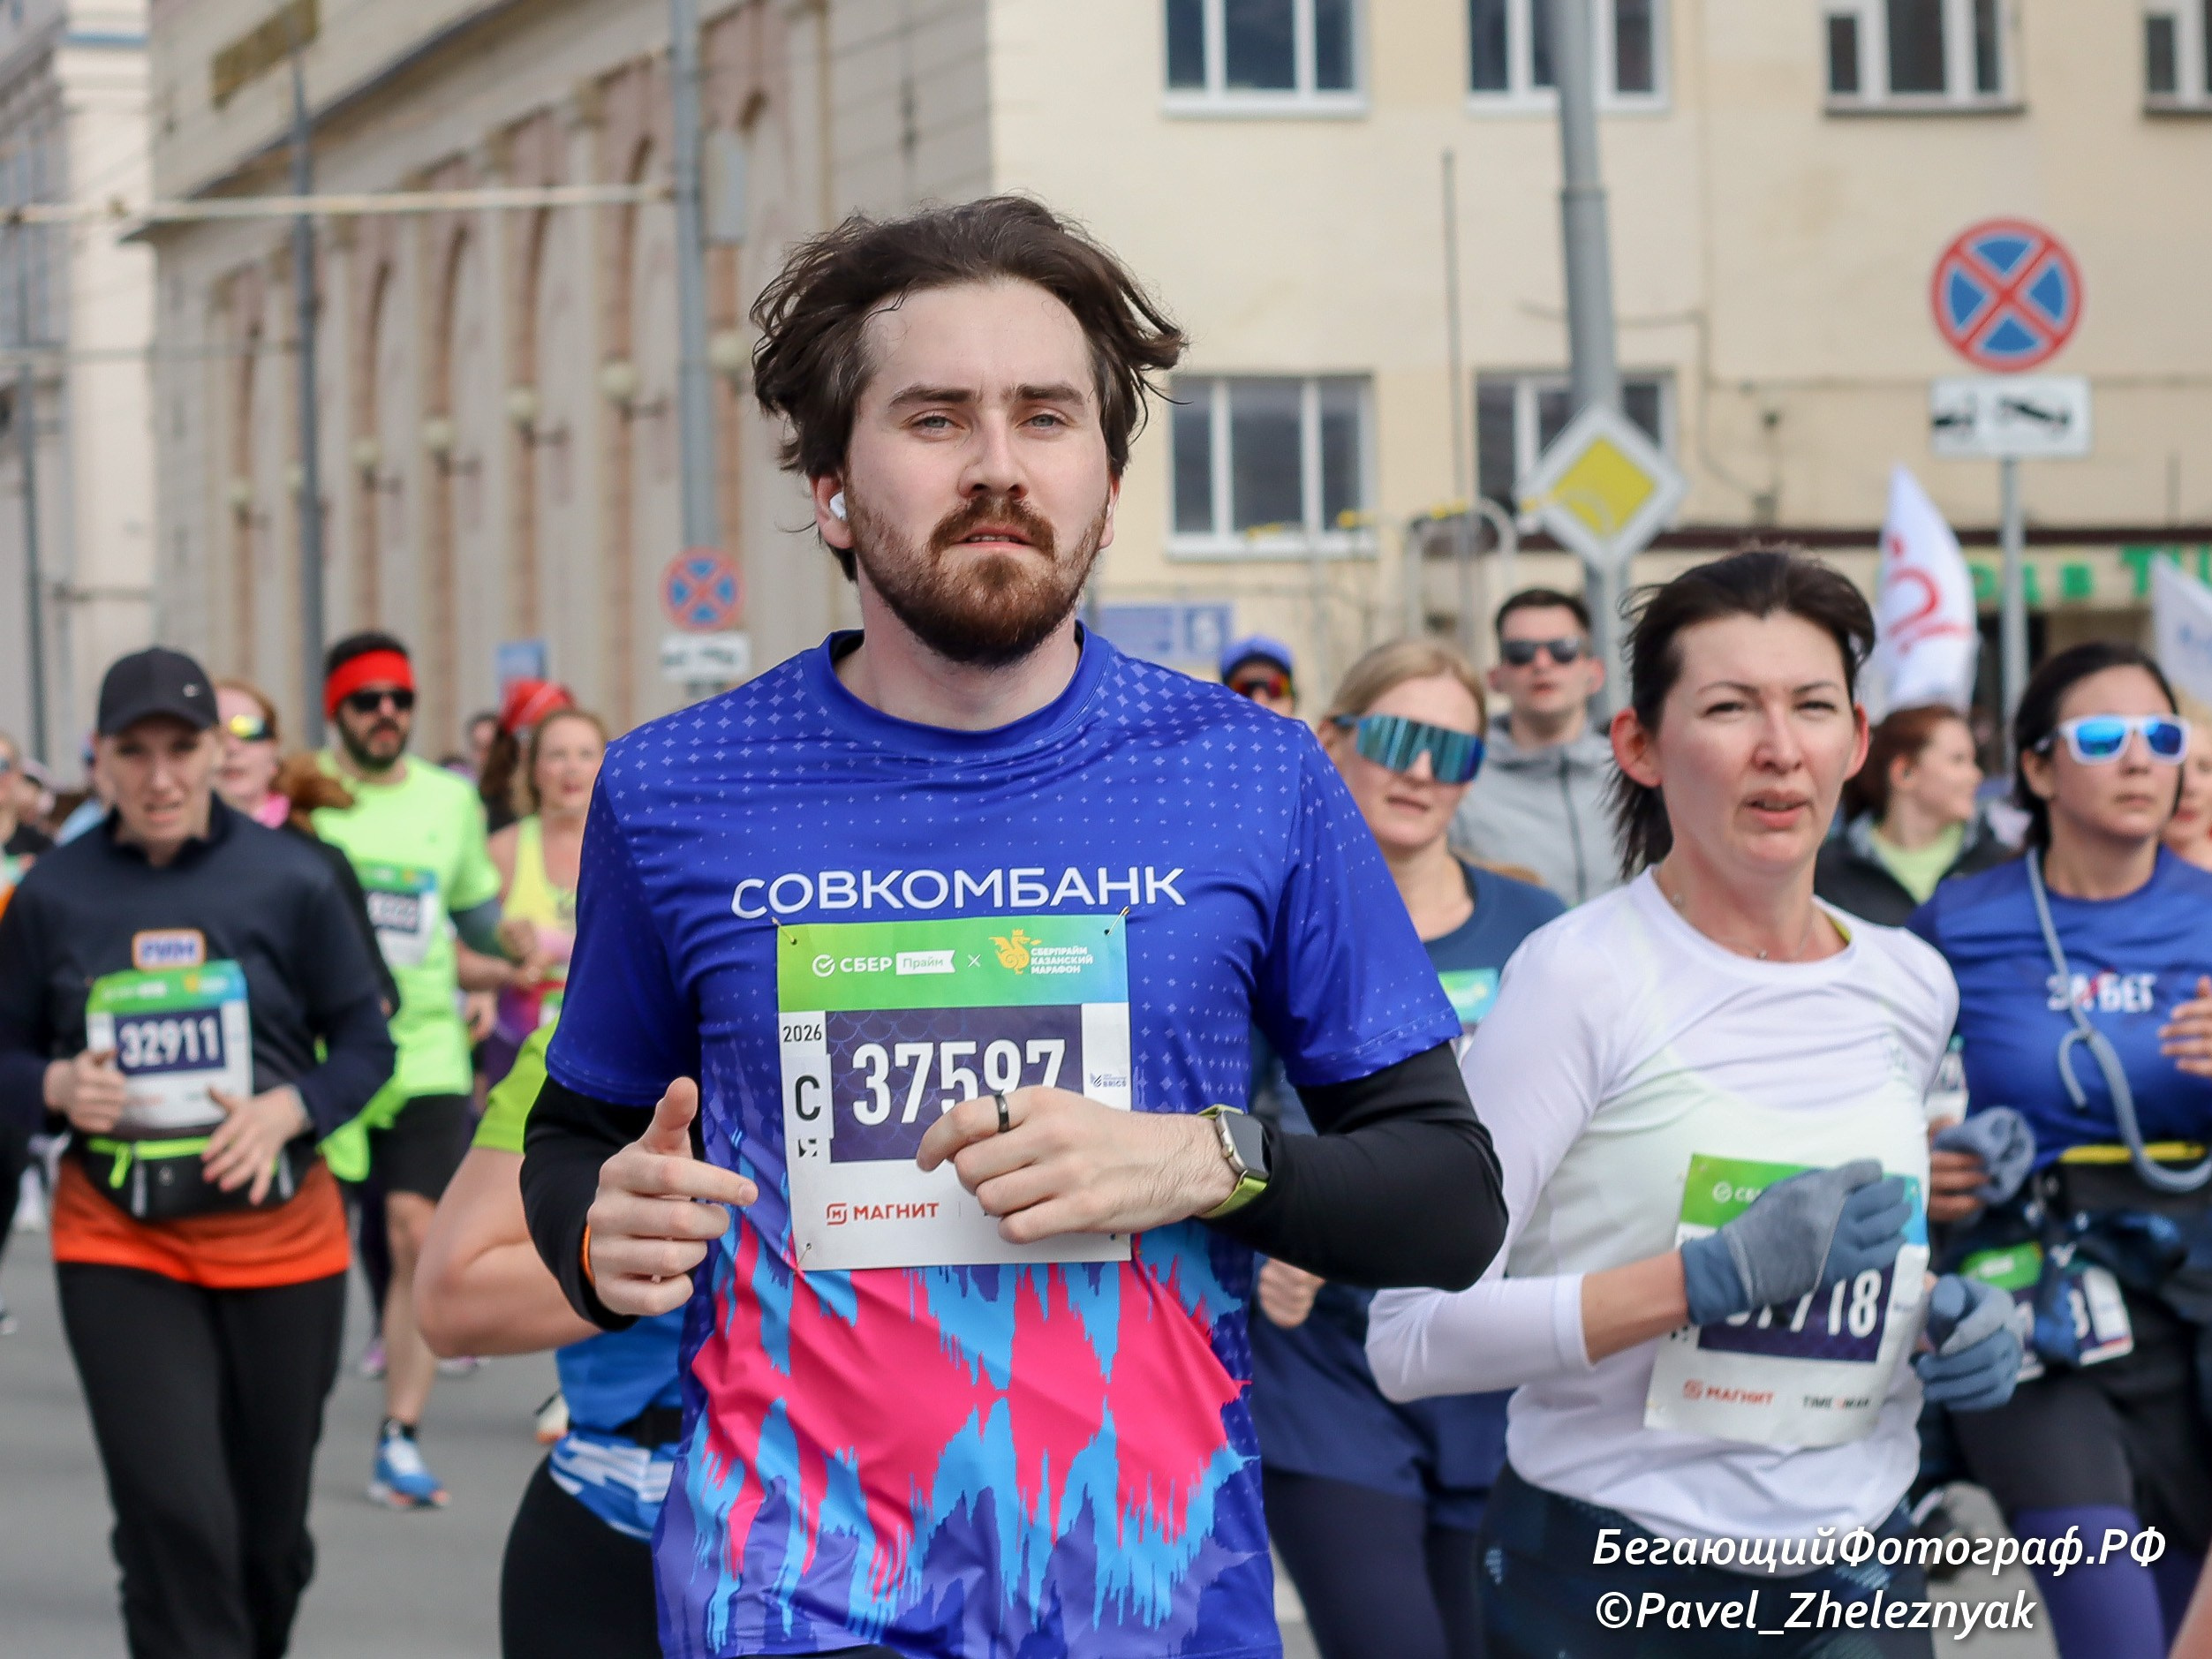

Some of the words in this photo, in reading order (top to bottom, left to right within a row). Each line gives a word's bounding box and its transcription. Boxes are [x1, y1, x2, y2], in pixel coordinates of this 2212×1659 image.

[730, 866, 1187, 919] СОВКОМБАНК
[1031, 946, 1089, 957] СБЕРПРАЙМ
[1031, 954, 1093, 966] КАЗАНСКИЙ
[840, 956, 893, 973] СБЕР
[902, 956, 944, 971] Прайм
[1031, 964, 1082, 975] МАРАФОН
[119, 1016, 220, 1068] 32911
[782, 1024, 822, 1043] 2026
[852, 1038, 1066, 1126] 37597
[853, 1203, 940, 1221] МАГНИТ
